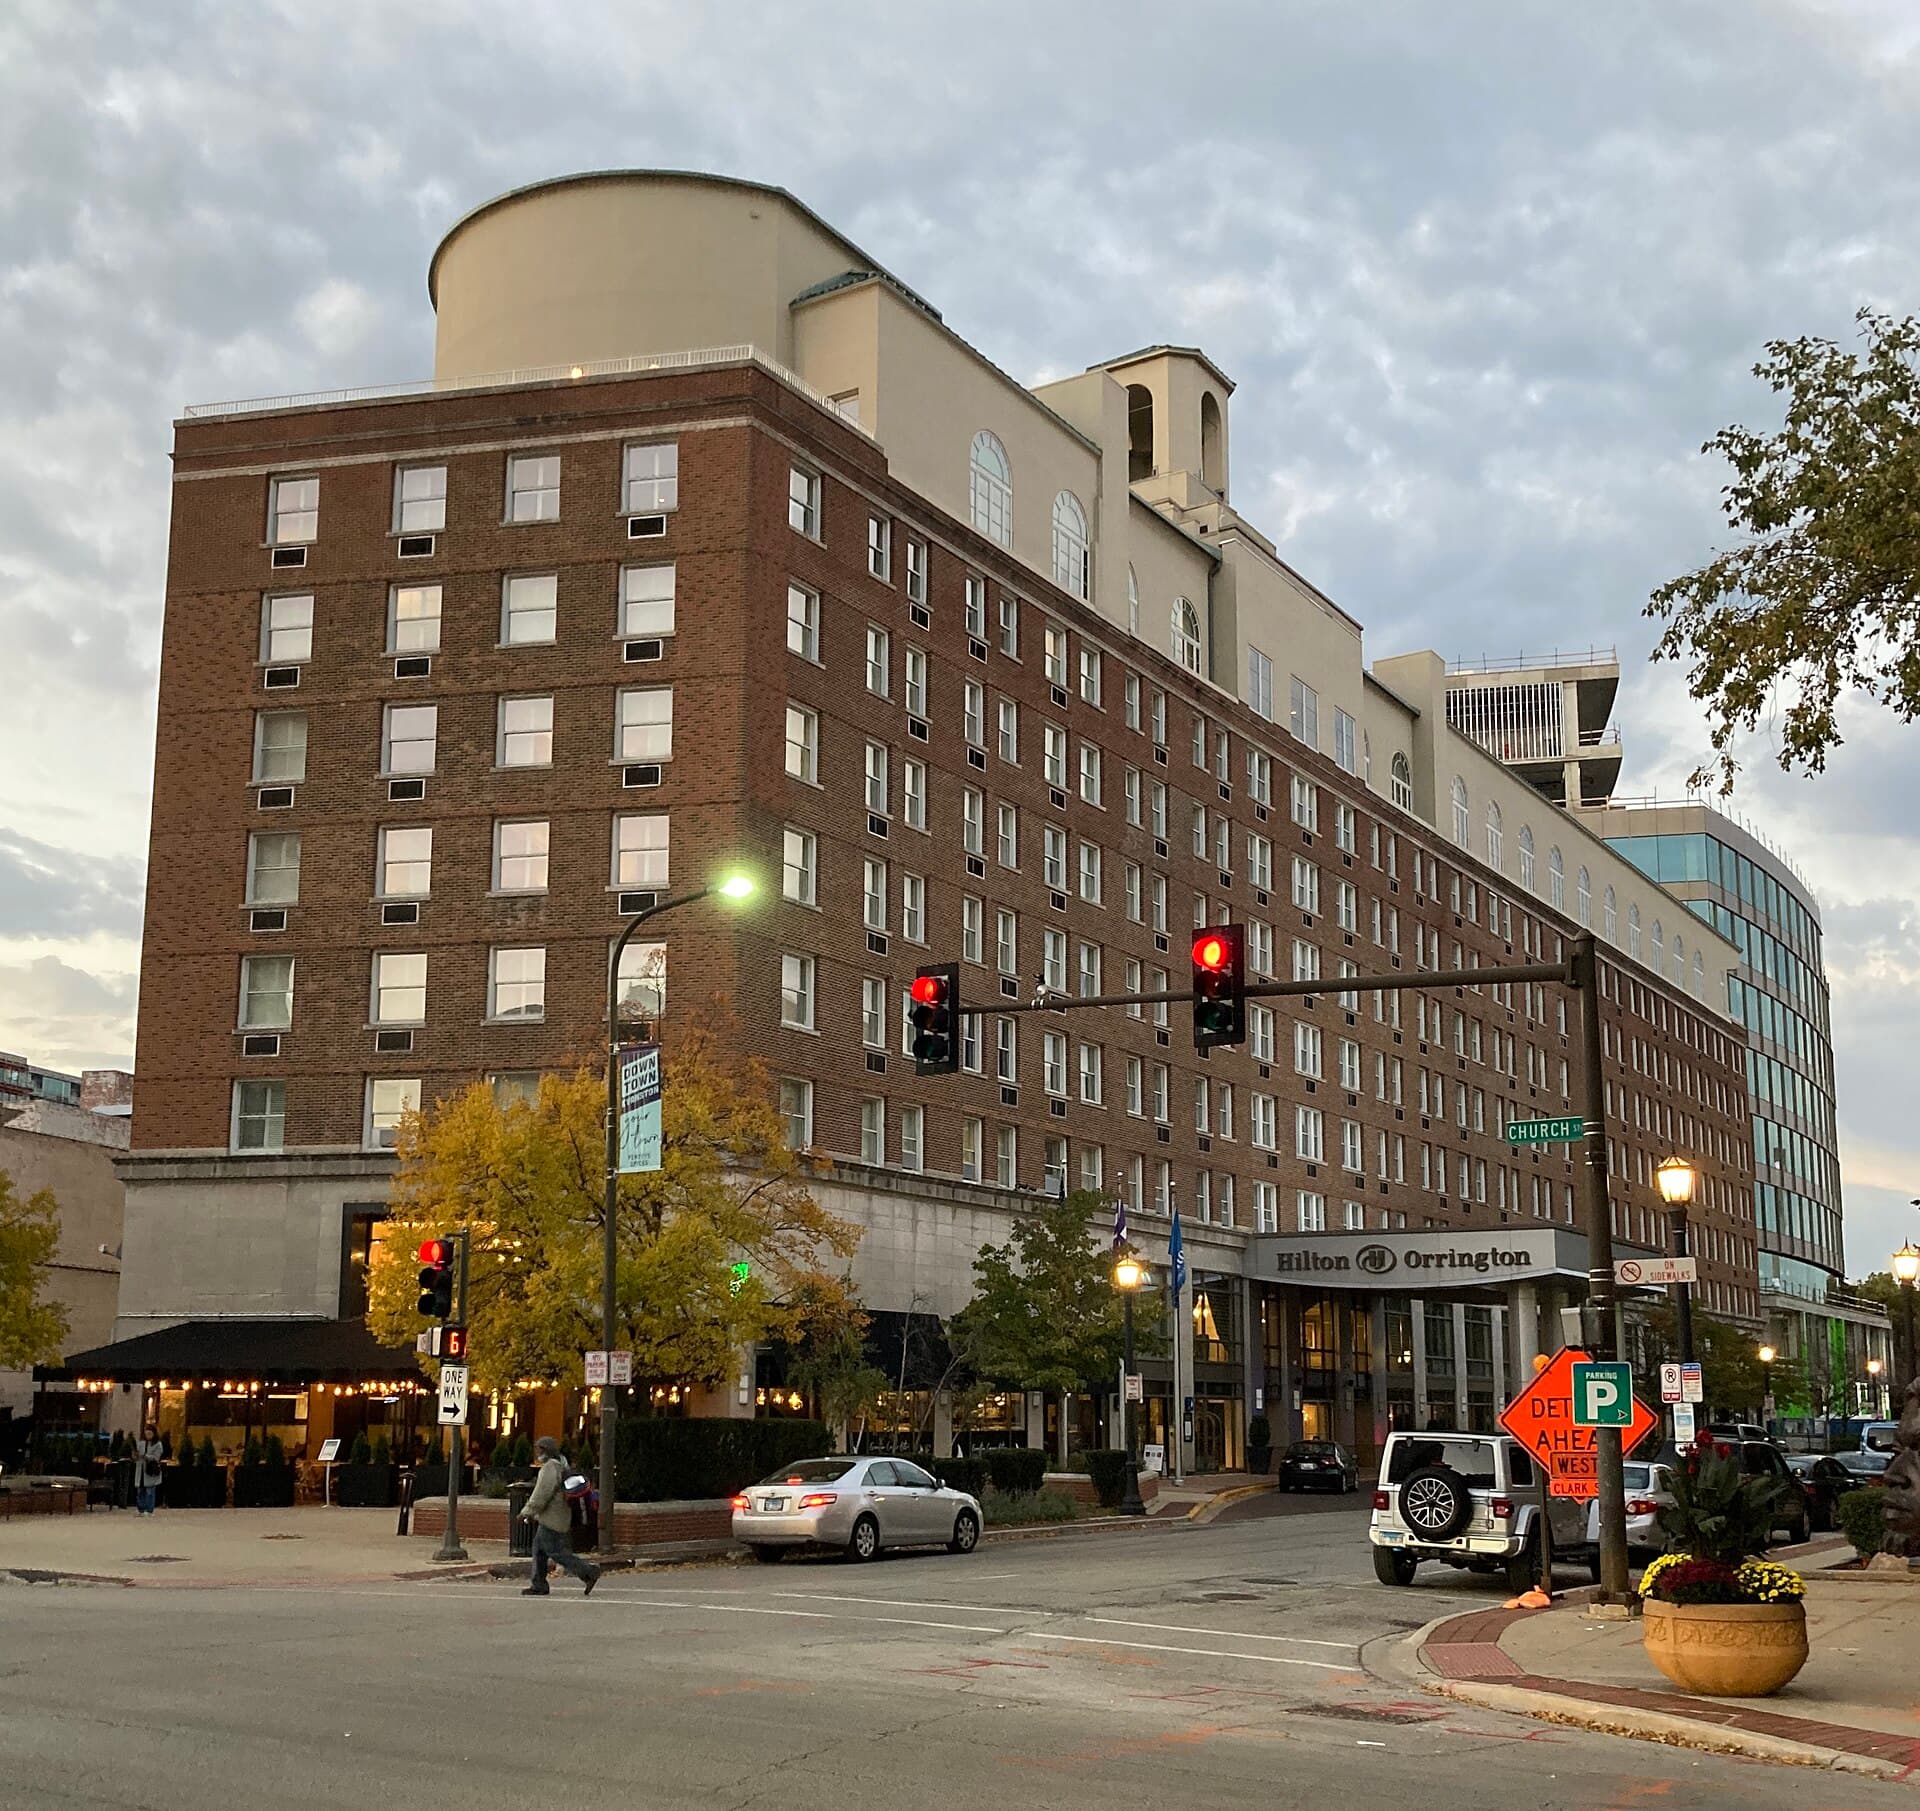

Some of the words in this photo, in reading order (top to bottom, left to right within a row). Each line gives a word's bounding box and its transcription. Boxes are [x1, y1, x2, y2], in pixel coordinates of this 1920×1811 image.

[624, 1056, 656, 1080] DOWN
[624, 1070, 656, 1094] TOWN
[1509, 1122, 1569, 1140] CHURCH
[1277, 1250, 1351, 1272] Hilton
[1403, 1247, 1532, 1273] Orrington
[1664, 1260, 1674, 1270] ON
[1650, 1271, 1691, 1281] SIDEWALKS
[450, 1332, 459, 1354] 6
[445, 1370, 463, 1384] ONE
[1585, 1372, 1618, 1380] PARKING
[443, 1386, 463, 1399] WAY
[1586, 1381, 1618, 1420] P
[1531, 1398, 1573, 1418] DET
[1536, 1429, 1598, 1451] AHEA
[1557, 1457, 1598, 1474] WEST
[1553, 1482, 1589, 1495] CLARK
